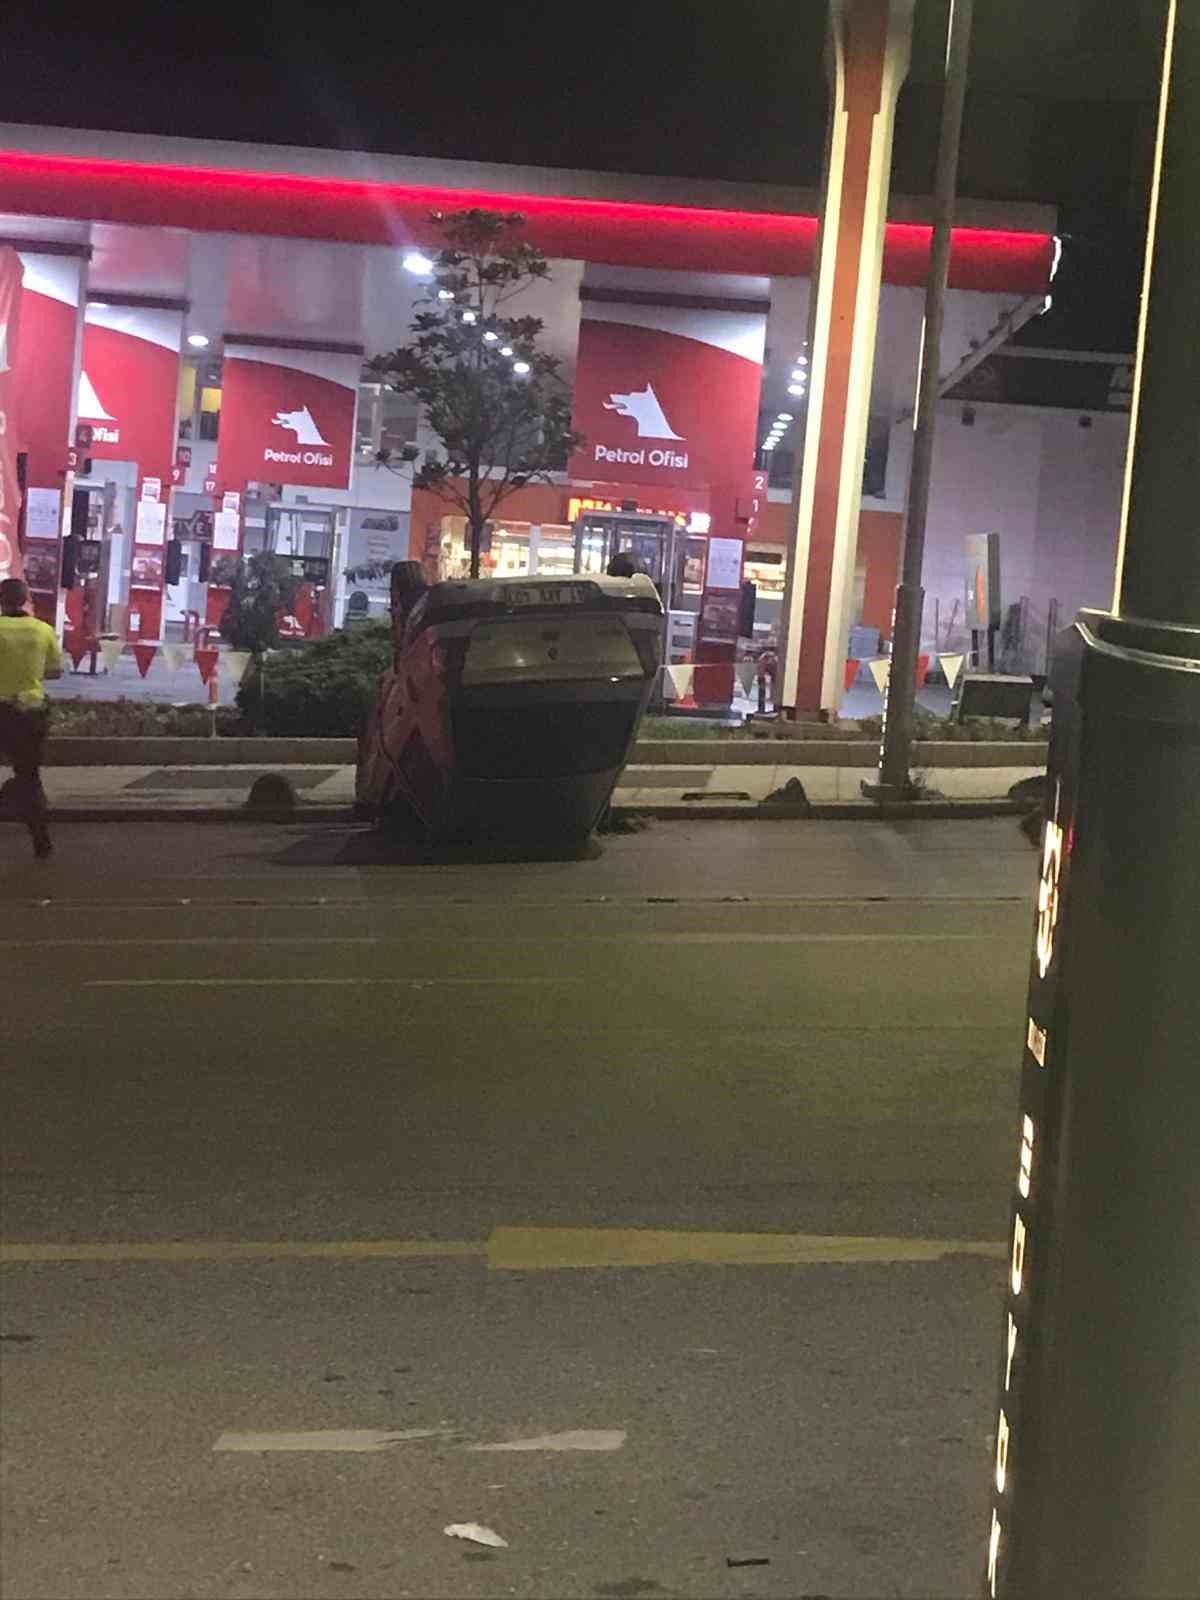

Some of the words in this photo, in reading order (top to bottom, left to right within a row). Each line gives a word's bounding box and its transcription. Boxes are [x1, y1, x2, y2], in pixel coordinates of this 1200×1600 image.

[264, 448, 301, 463] Petrol
[303, 451, 333, 466] Ofisi
[595, 444, 645, 465] Petrol
[649, 449, 689, 469] Ofisi
[171, 469, 180, 481] 9
[754, 475, 765, 490] 2
[752, 499, 759, 513] 1
